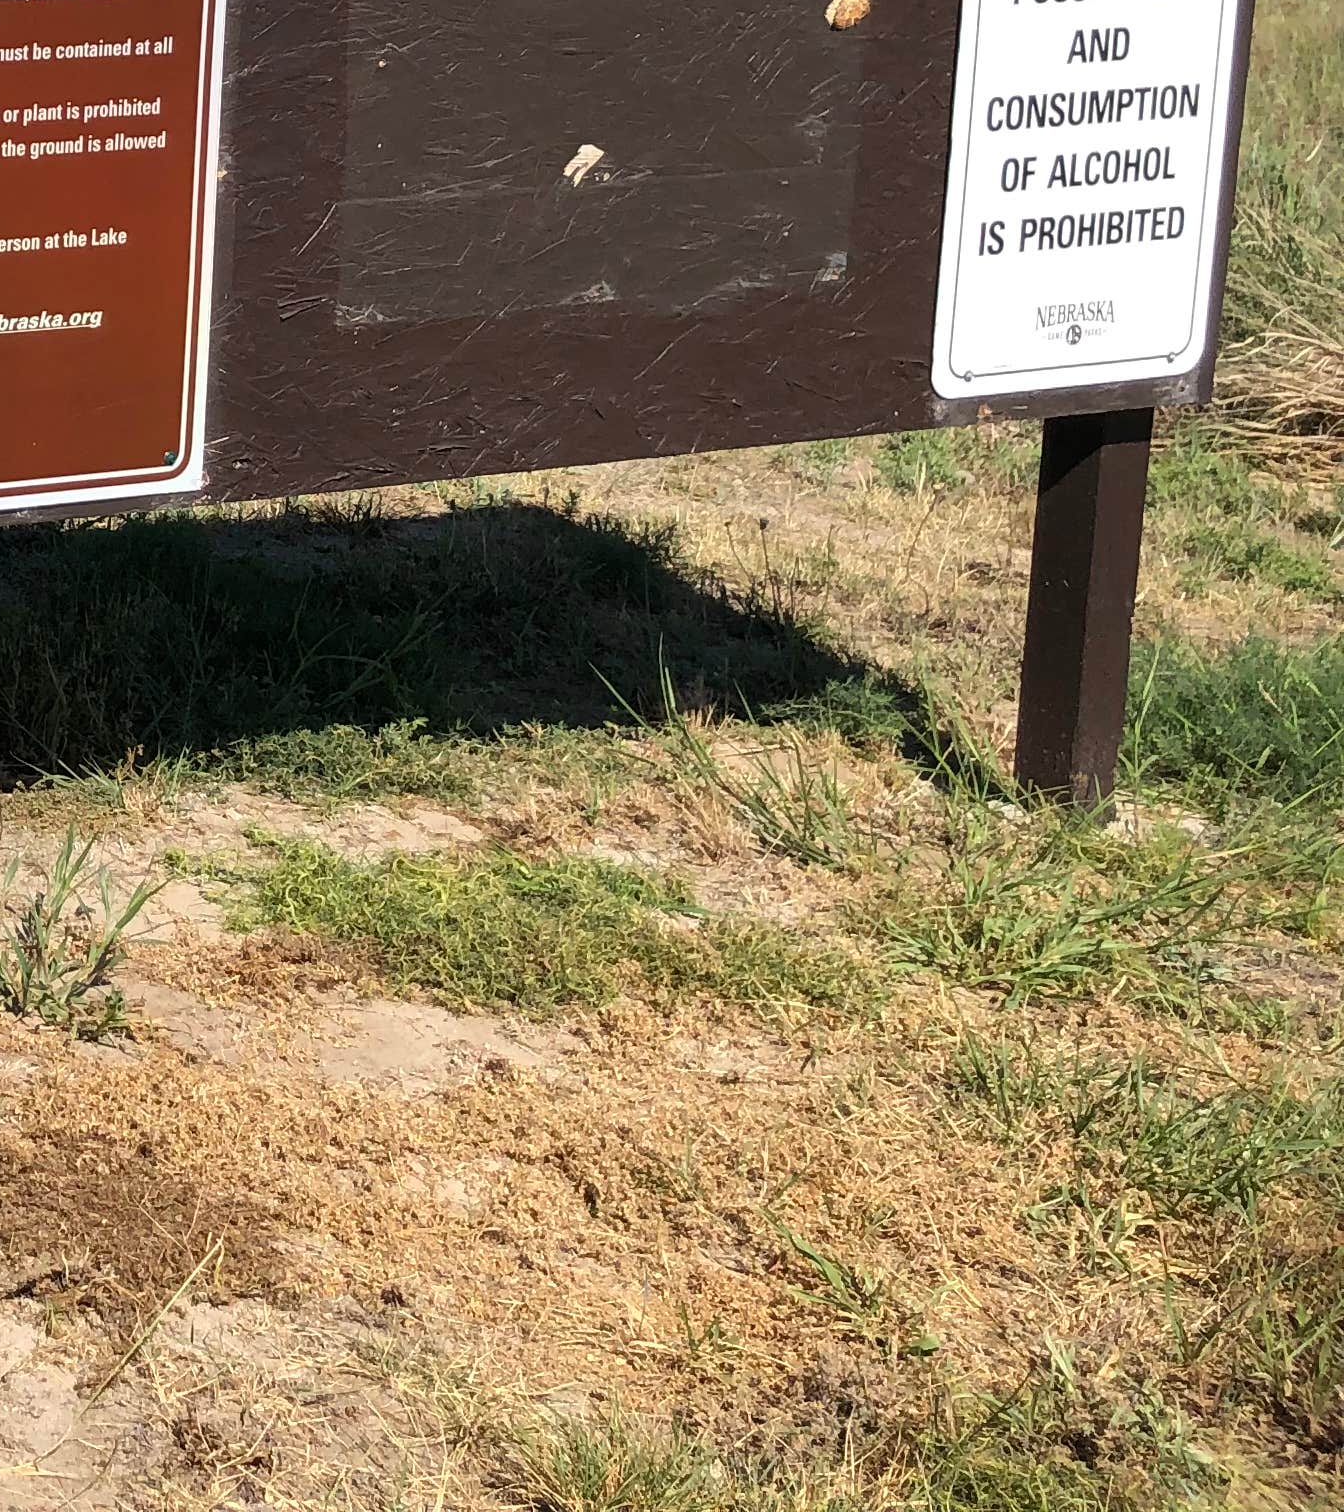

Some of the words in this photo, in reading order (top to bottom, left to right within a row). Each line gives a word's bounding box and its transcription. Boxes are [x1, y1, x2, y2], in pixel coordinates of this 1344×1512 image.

[1068, 28, 1129, 63] AND
[987, 85, 1199, 131] CONSUMPTION
[1001, 157, 1036, 192] OF
[1048, 147, 1175, 188] ALCOHOL
[979, 221, 1005, 256] IS
[1020, 207, 1184, 252] PROHIBITED
[1036, 300, 1115, 331] NEBRASKA
